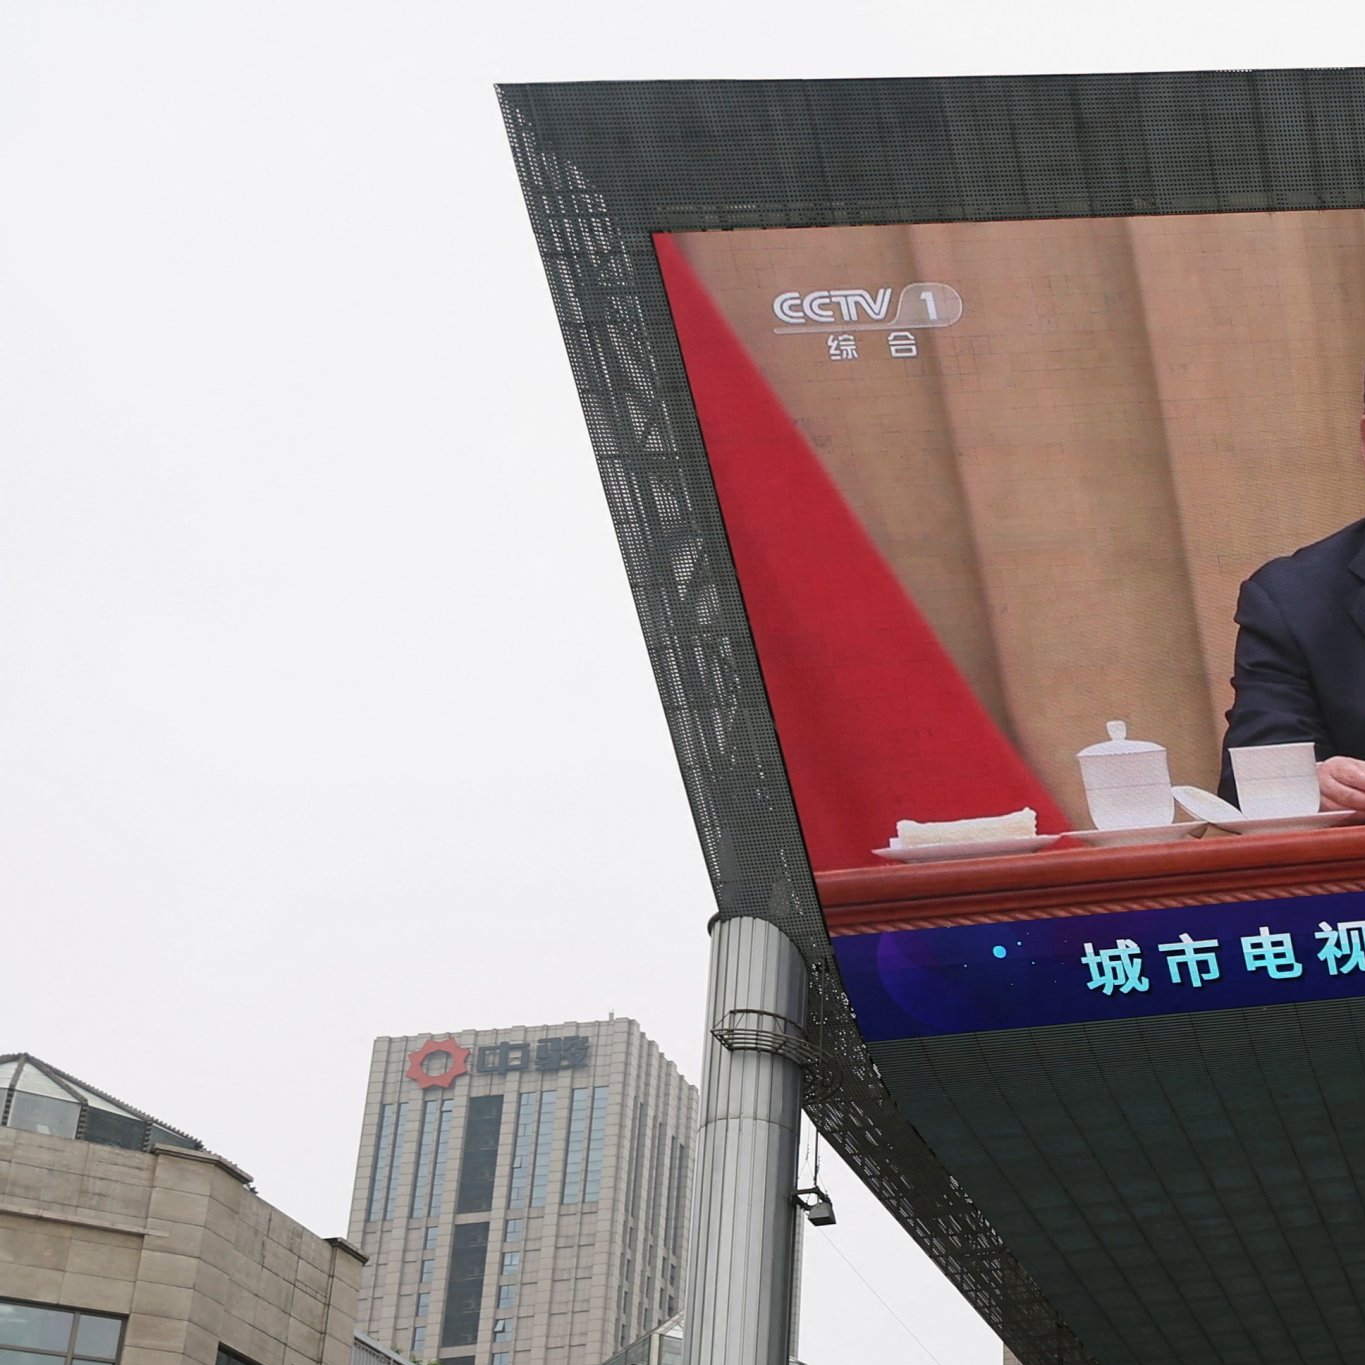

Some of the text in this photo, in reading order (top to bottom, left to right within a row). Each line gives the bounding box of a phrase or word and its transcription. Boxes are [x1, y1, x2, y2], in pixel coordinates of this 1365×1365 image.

[772, 287, 938, 324] CCTV 1
[826, 331, 918, 361] 综合
[475, 1034, 591, 1075] 中骏
